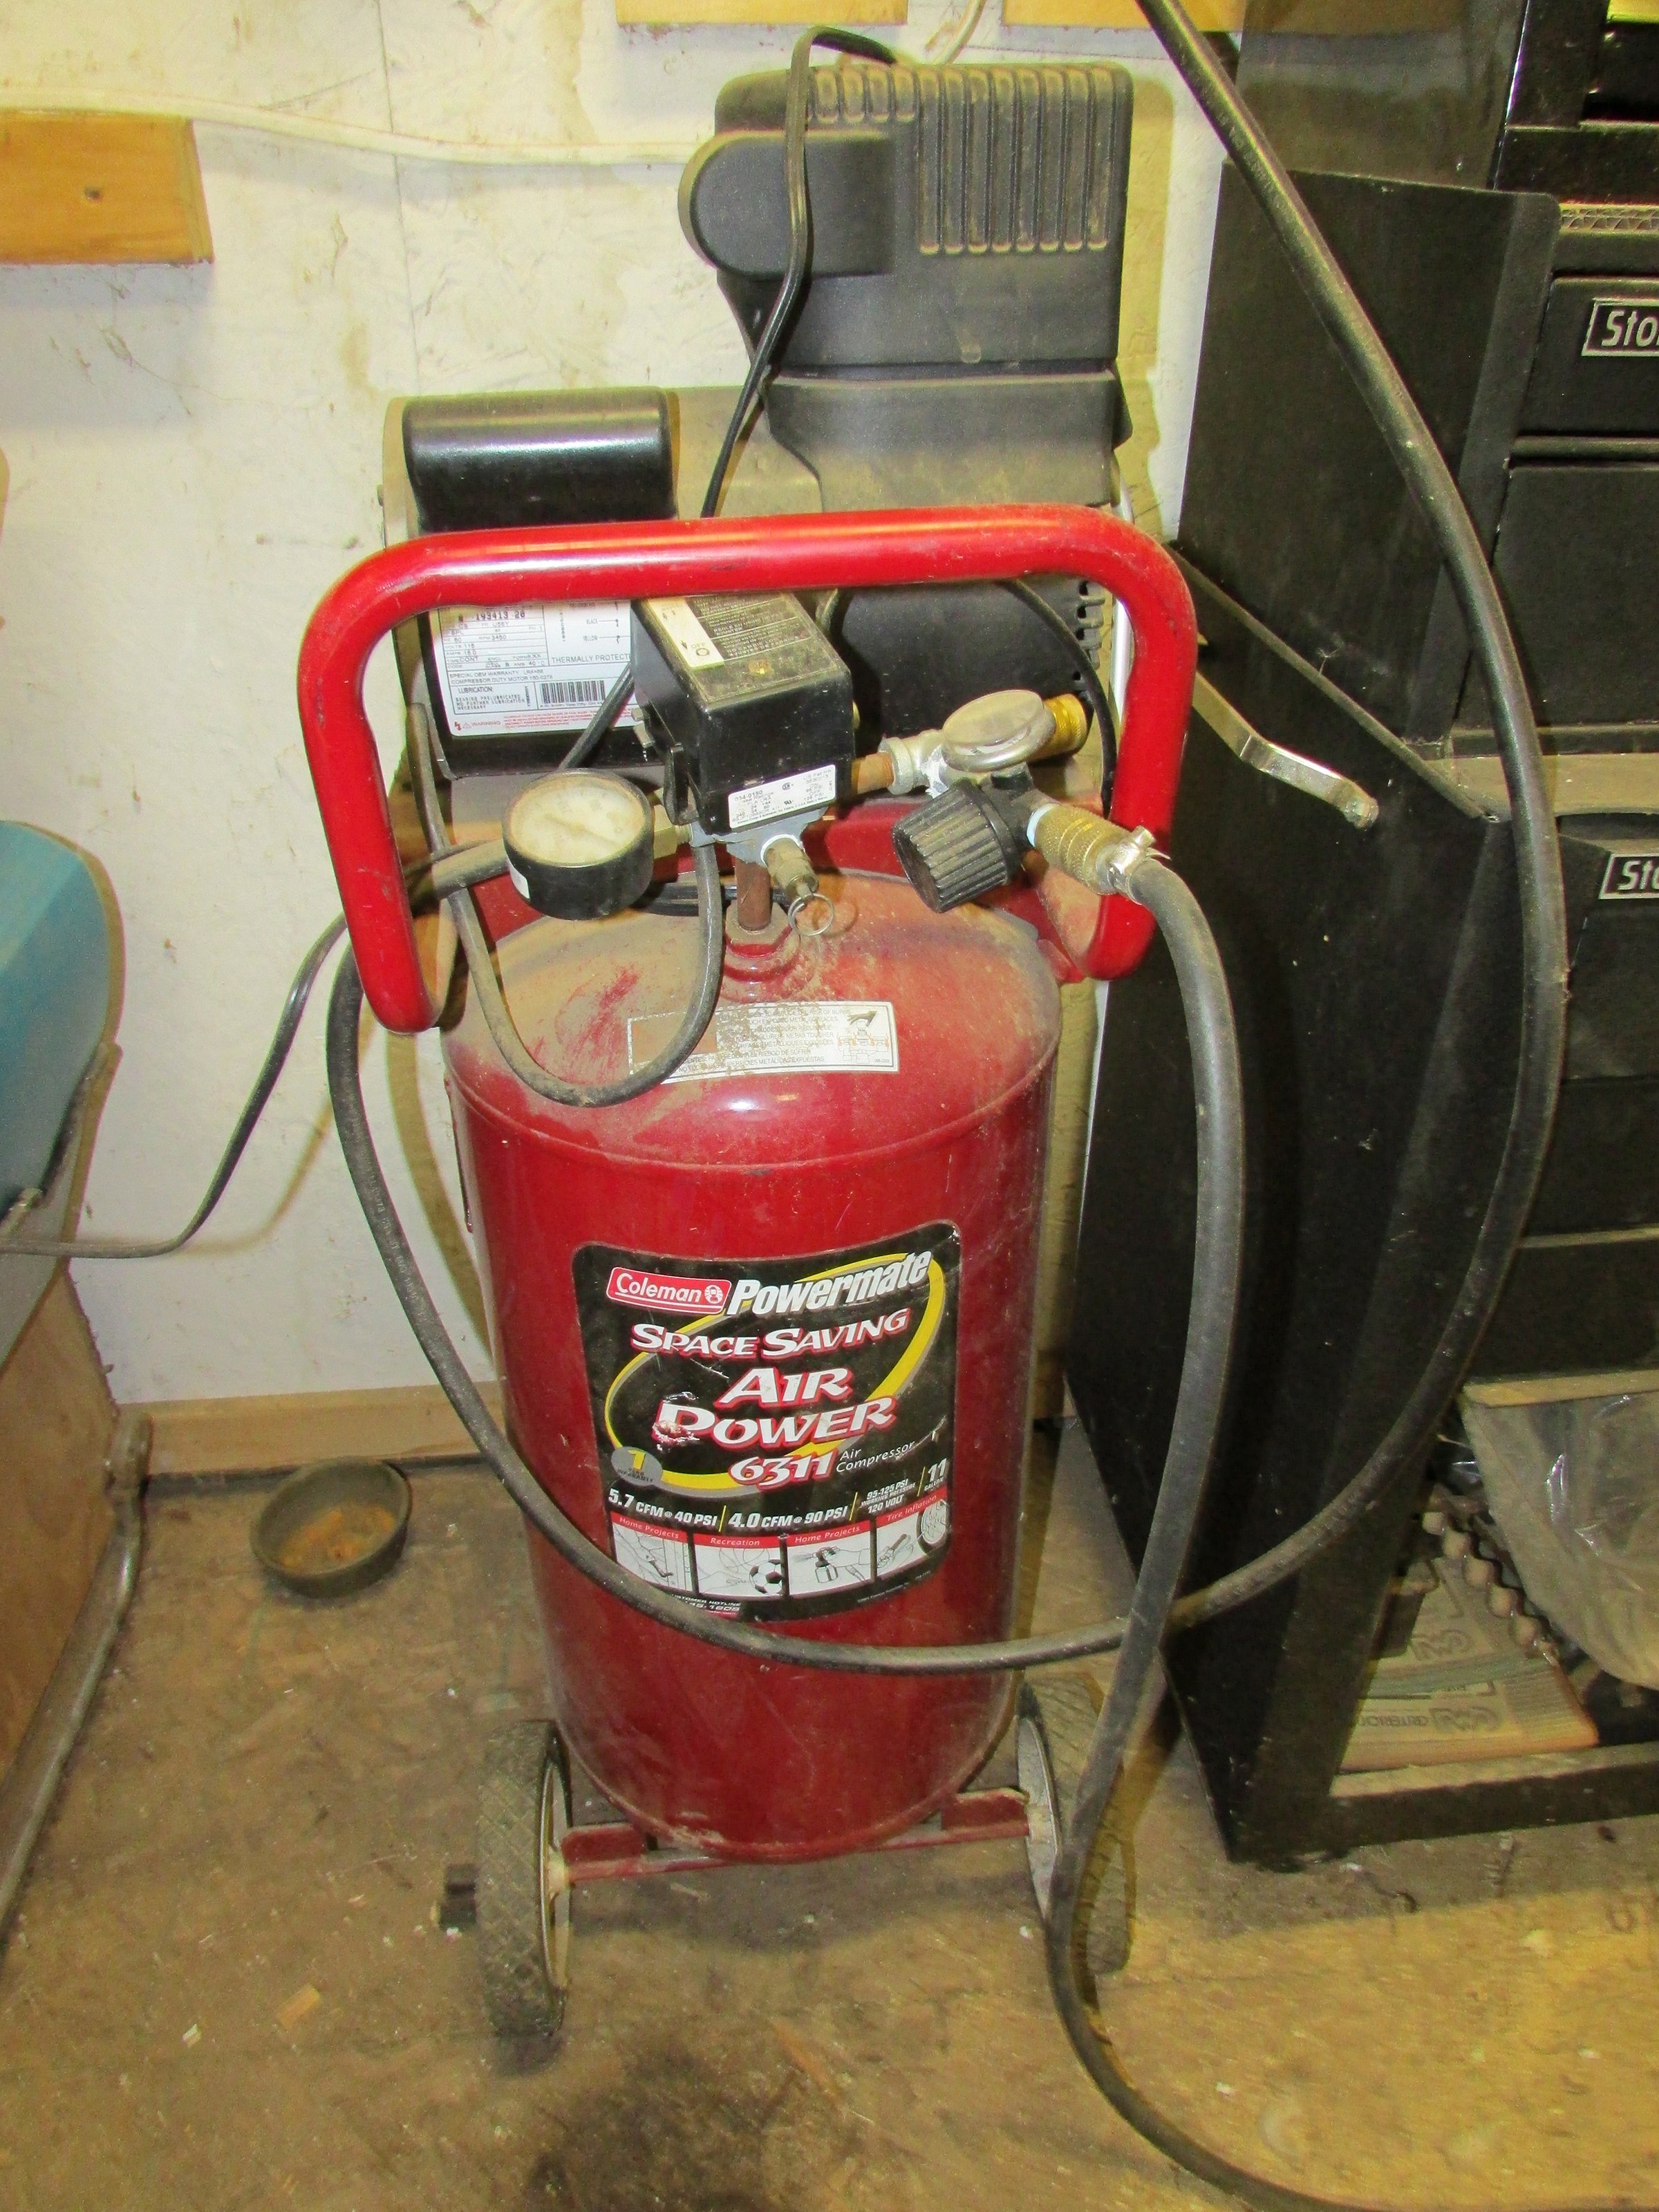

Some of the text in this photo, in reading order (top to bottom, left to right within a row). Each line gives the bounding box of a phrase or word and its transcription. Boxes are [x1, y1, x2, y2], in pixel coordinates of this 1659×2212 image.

[1601, 311, 1659, 347] Sto
[552, 653, 630, 664] THERMALLY PROTECT
[616, 1250, 932, 1315] Coleman Powermate
[631, 1307, 910, 1357] SPACE SAVING
[718, 1367, 850, 1405] AIR
[654, 1396, 894, 1445] POWER
[628, 1450, 646, 1470] 1
[836, 1441, 915, 1472] Compressor
[840, 1448, 861, 1461] Air
[730, 1452, 832, 1486] 6311
[928, 1458, 947, 1483] 11
[866, 1479, 909, 1500] 95-125 PSI
[608, 1488, 635, 1508] 5.7
[635, 1501, 664, 1517] CFM
[674, 1510, 693, 1523] 40
[694, 1514, 718, 1526] PSI
[868, 1494, 904, 1514] 120 VOLT
[886, 1494, 937, 1521] Tire Inflation
[619, 1517, 679, 1539] Home Projects
[728, 1512, 761, 1528] 4.0
[761, 1515, 792, 1527] CFM
[804, 1510, 824, 1523] 90
[824, 1506, 848, 1521] PSI
[711, 1537, 760, 1546] Recreation
[795, 1525, 860, 1544] Home Projects
